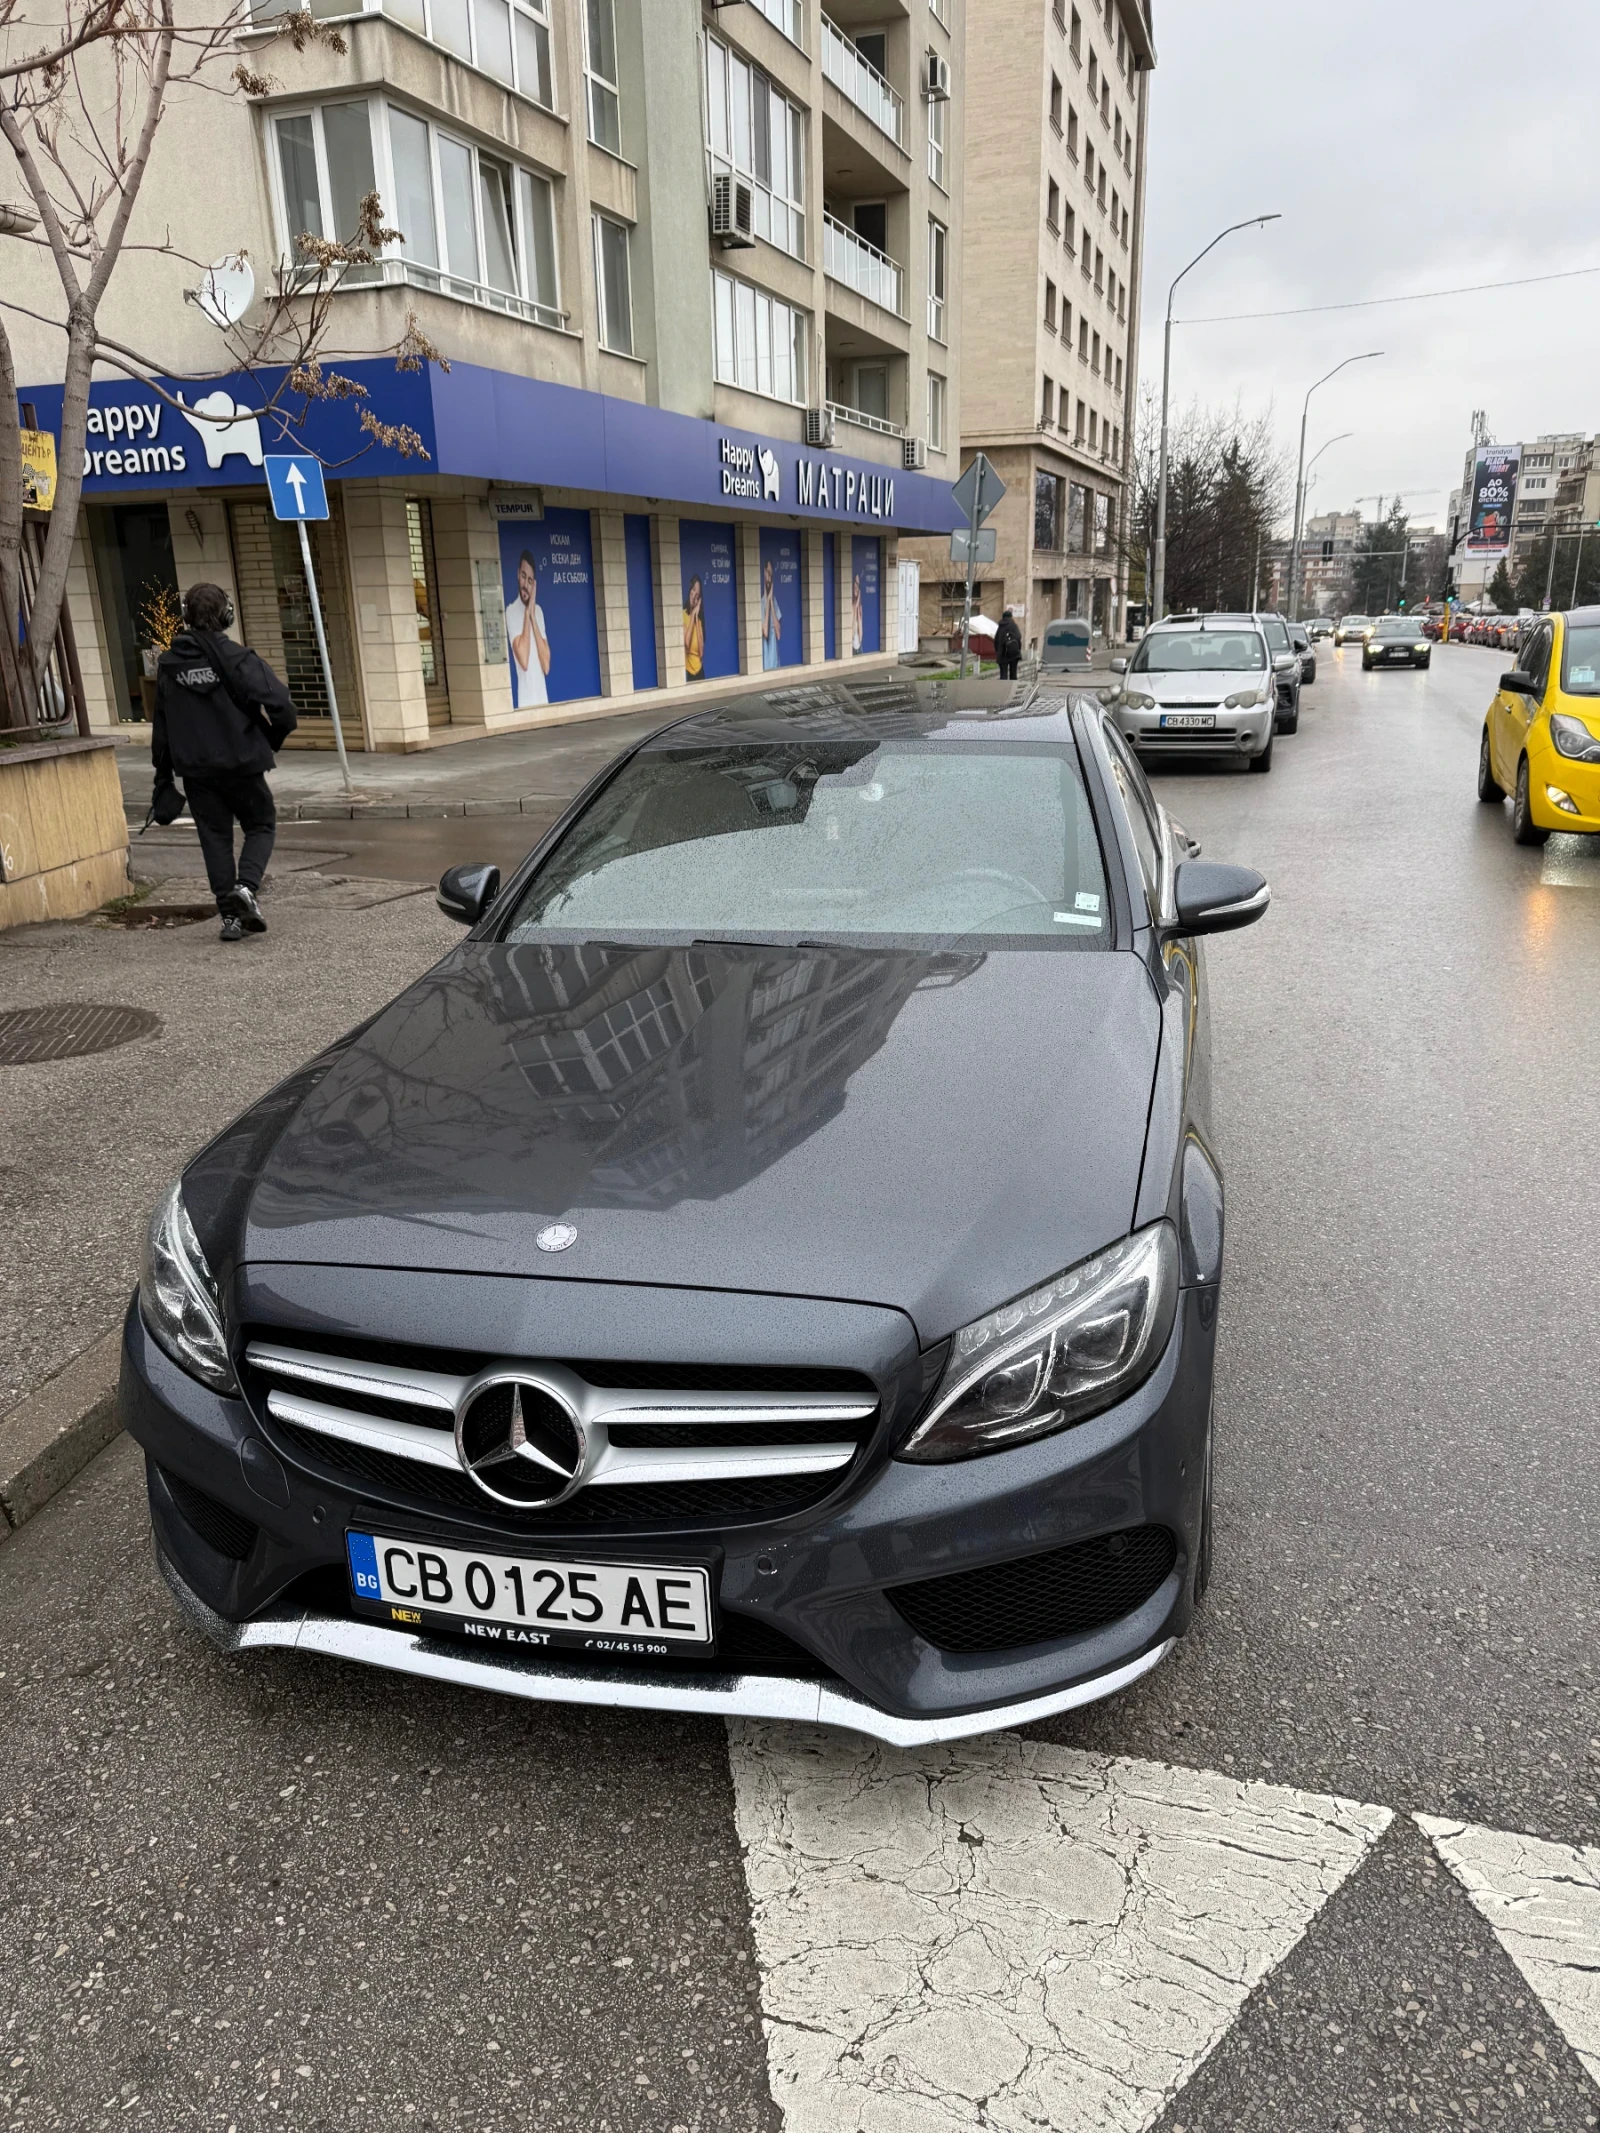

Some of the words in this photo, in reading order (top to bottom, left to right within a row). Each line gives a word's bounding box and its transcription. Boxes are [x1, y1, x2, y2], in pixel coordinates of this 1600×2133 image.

[62, 403, 161, 442] appy
[21, 443, 52, 459] ЦЕНТЪР
[722, 438, 755, 474] Happy
[723, 470, 760, 498] Dreams
[798, 459, 894, 519] МАТРАЦИ
[1487, 479, 1502, 488] ДО
[1479, 487, 1509, 498] 80%
[495, 504, 534, 514] TEMPUR
[549, 534, 571, 546] ИСКАМ
[551, 553, 569, 565] ВСЕКИ
[570, 553, 582, 566] ДЕН
[553, 572, 562, 584] ДА
[562, 572, 567, 583] Е
[180, 667, 216, 685] VANS
[1166, 717, 1178, 726] CB
[1179, 717, 1200, 726] 4330
[1201, 717, 1213, 726] MC
[356, 1572, 378, 1590] BG
[384, 1547, 453, 1604] CB
[465, 1560, 604, 1624] 0125
[620, 1576, 696, 1632] AE
[391, 1607, 421, 1623] NEW
[463, 1622, 502, 1640] NEW
[506, 1628, 551, 1646] EAST
[632, 1644, 644, 1653] 15
[646, 1644, 668, 1654] 900
